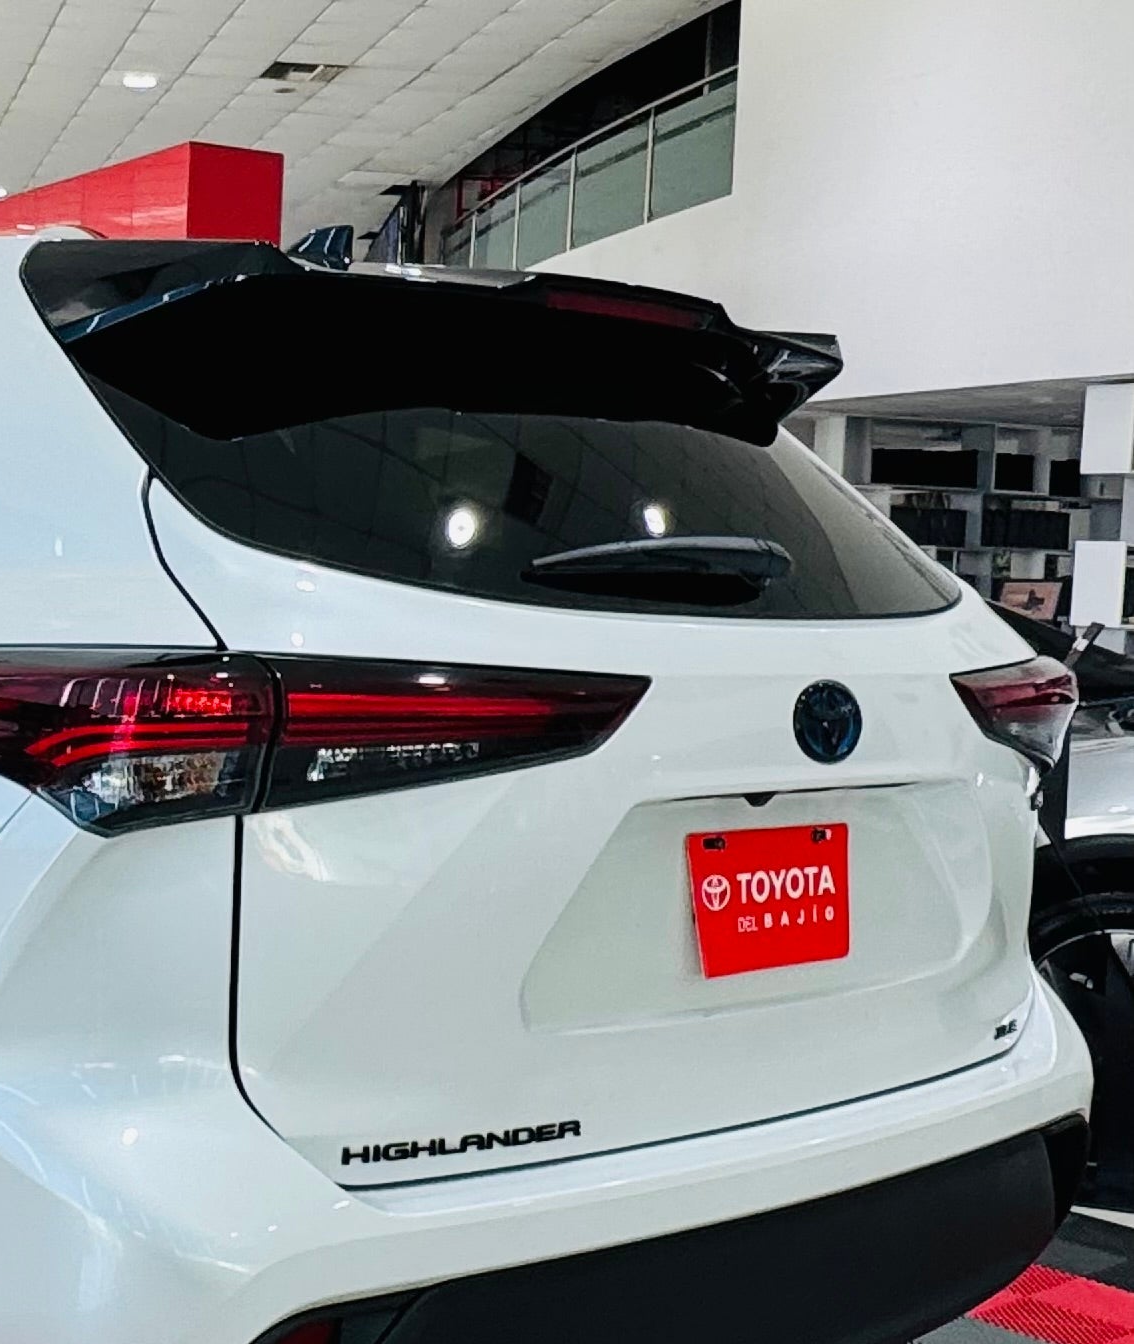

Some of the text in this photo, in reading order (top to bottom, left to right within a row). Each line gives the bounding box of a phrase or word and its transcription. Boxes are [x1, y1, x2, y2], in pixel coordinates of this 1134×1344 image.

[736, 865, 836, 904] TOYOTA
[737, 916, 758, 933] DEL
[341, 1119, 582, 1165] HIGHLANDER
